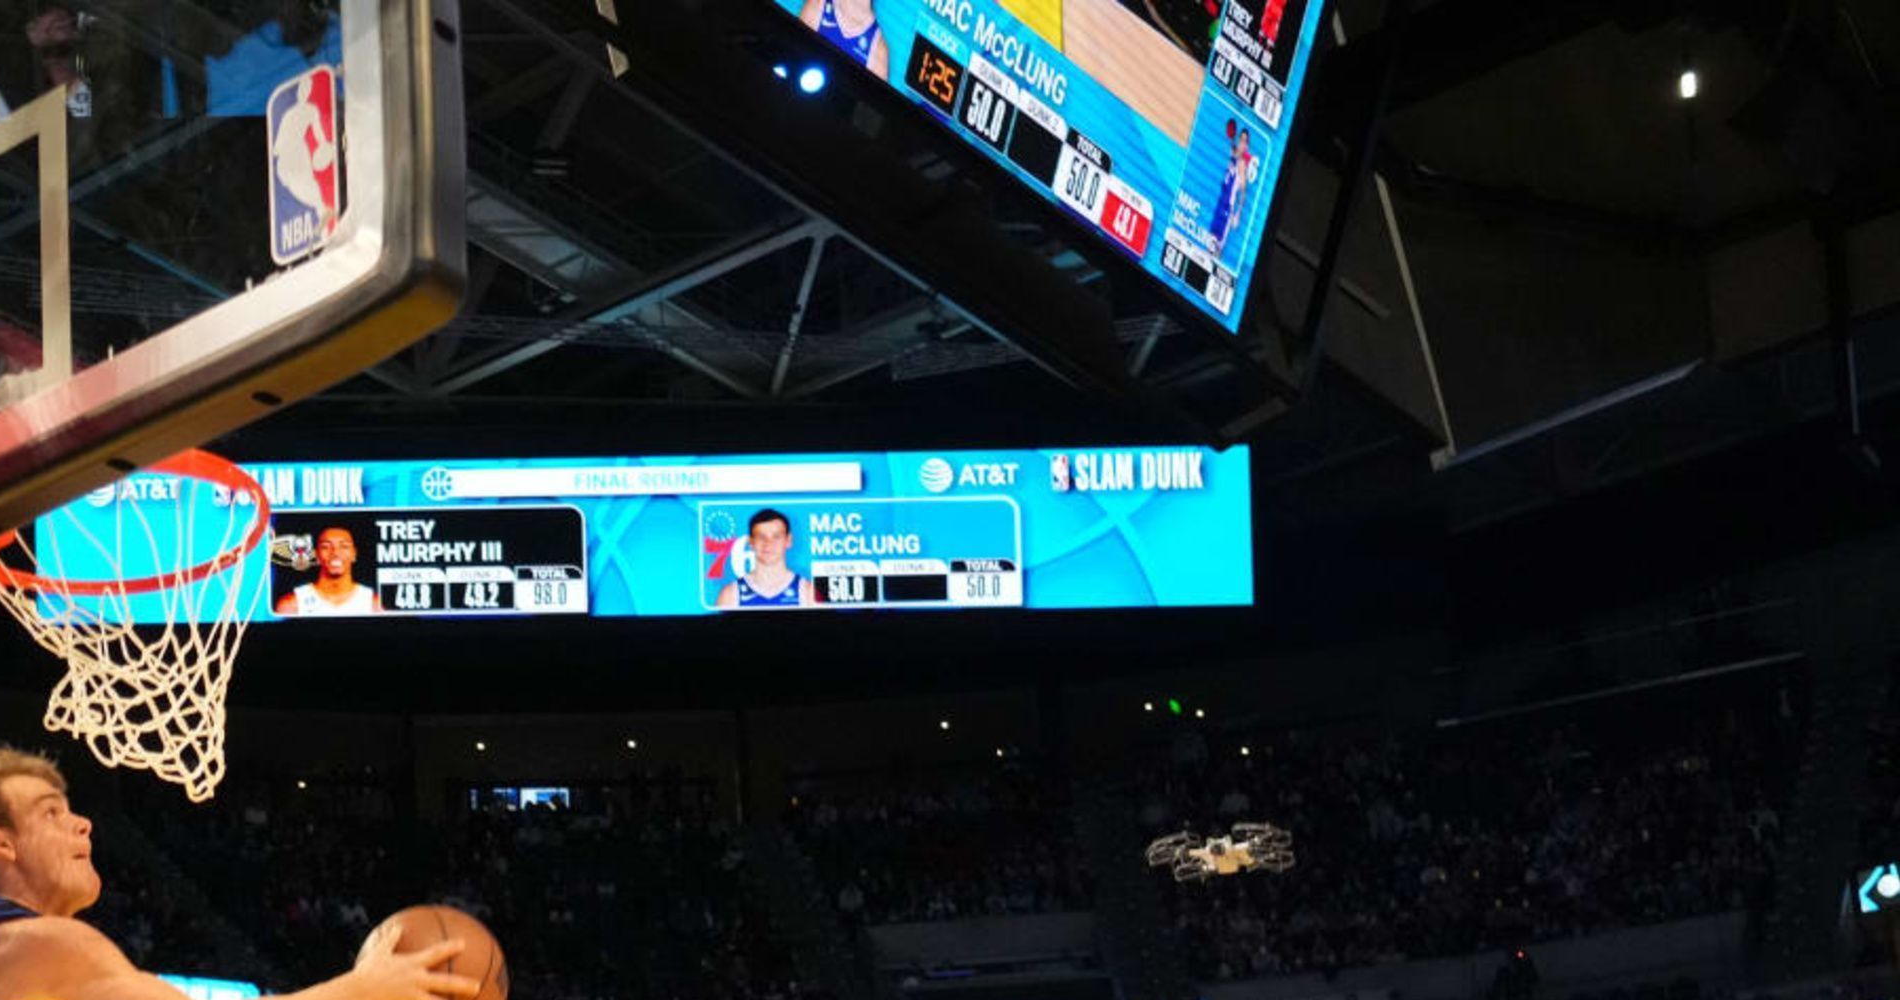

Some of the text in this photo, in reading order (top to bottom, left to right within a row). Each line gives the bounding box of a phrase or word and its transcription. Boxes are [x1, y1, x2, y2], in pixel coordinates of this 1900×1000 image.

[973, 11, 1069, 105] McCLUNG
[919, 51, 956, 105] 1:25
[966, 81, 1006, 143] 50.0
[1065, 155, 1101, 210] 50.0
[281, 211, 315, 252] NBA
[958, 462, 1019, 487] AT&T
[1074, 452, 1203, 492] SLAM DUNK
[121, 478, 179, 500] AT&T
[301, 467, 365, 505] DUNK
[375, 520, 436, 541] TREY
[809, 513, 862, 533] MAC
[377, 542, 502, 563] MURPHY III
[810, 535, 921, 556] McCLUNG
[531, 568, 569, 580] TOTAL
[964, 560, 1002, 572] TOTAL
[828, 576, 865, 601] 50.0
[966, 574, 1001, 598] 50.0
